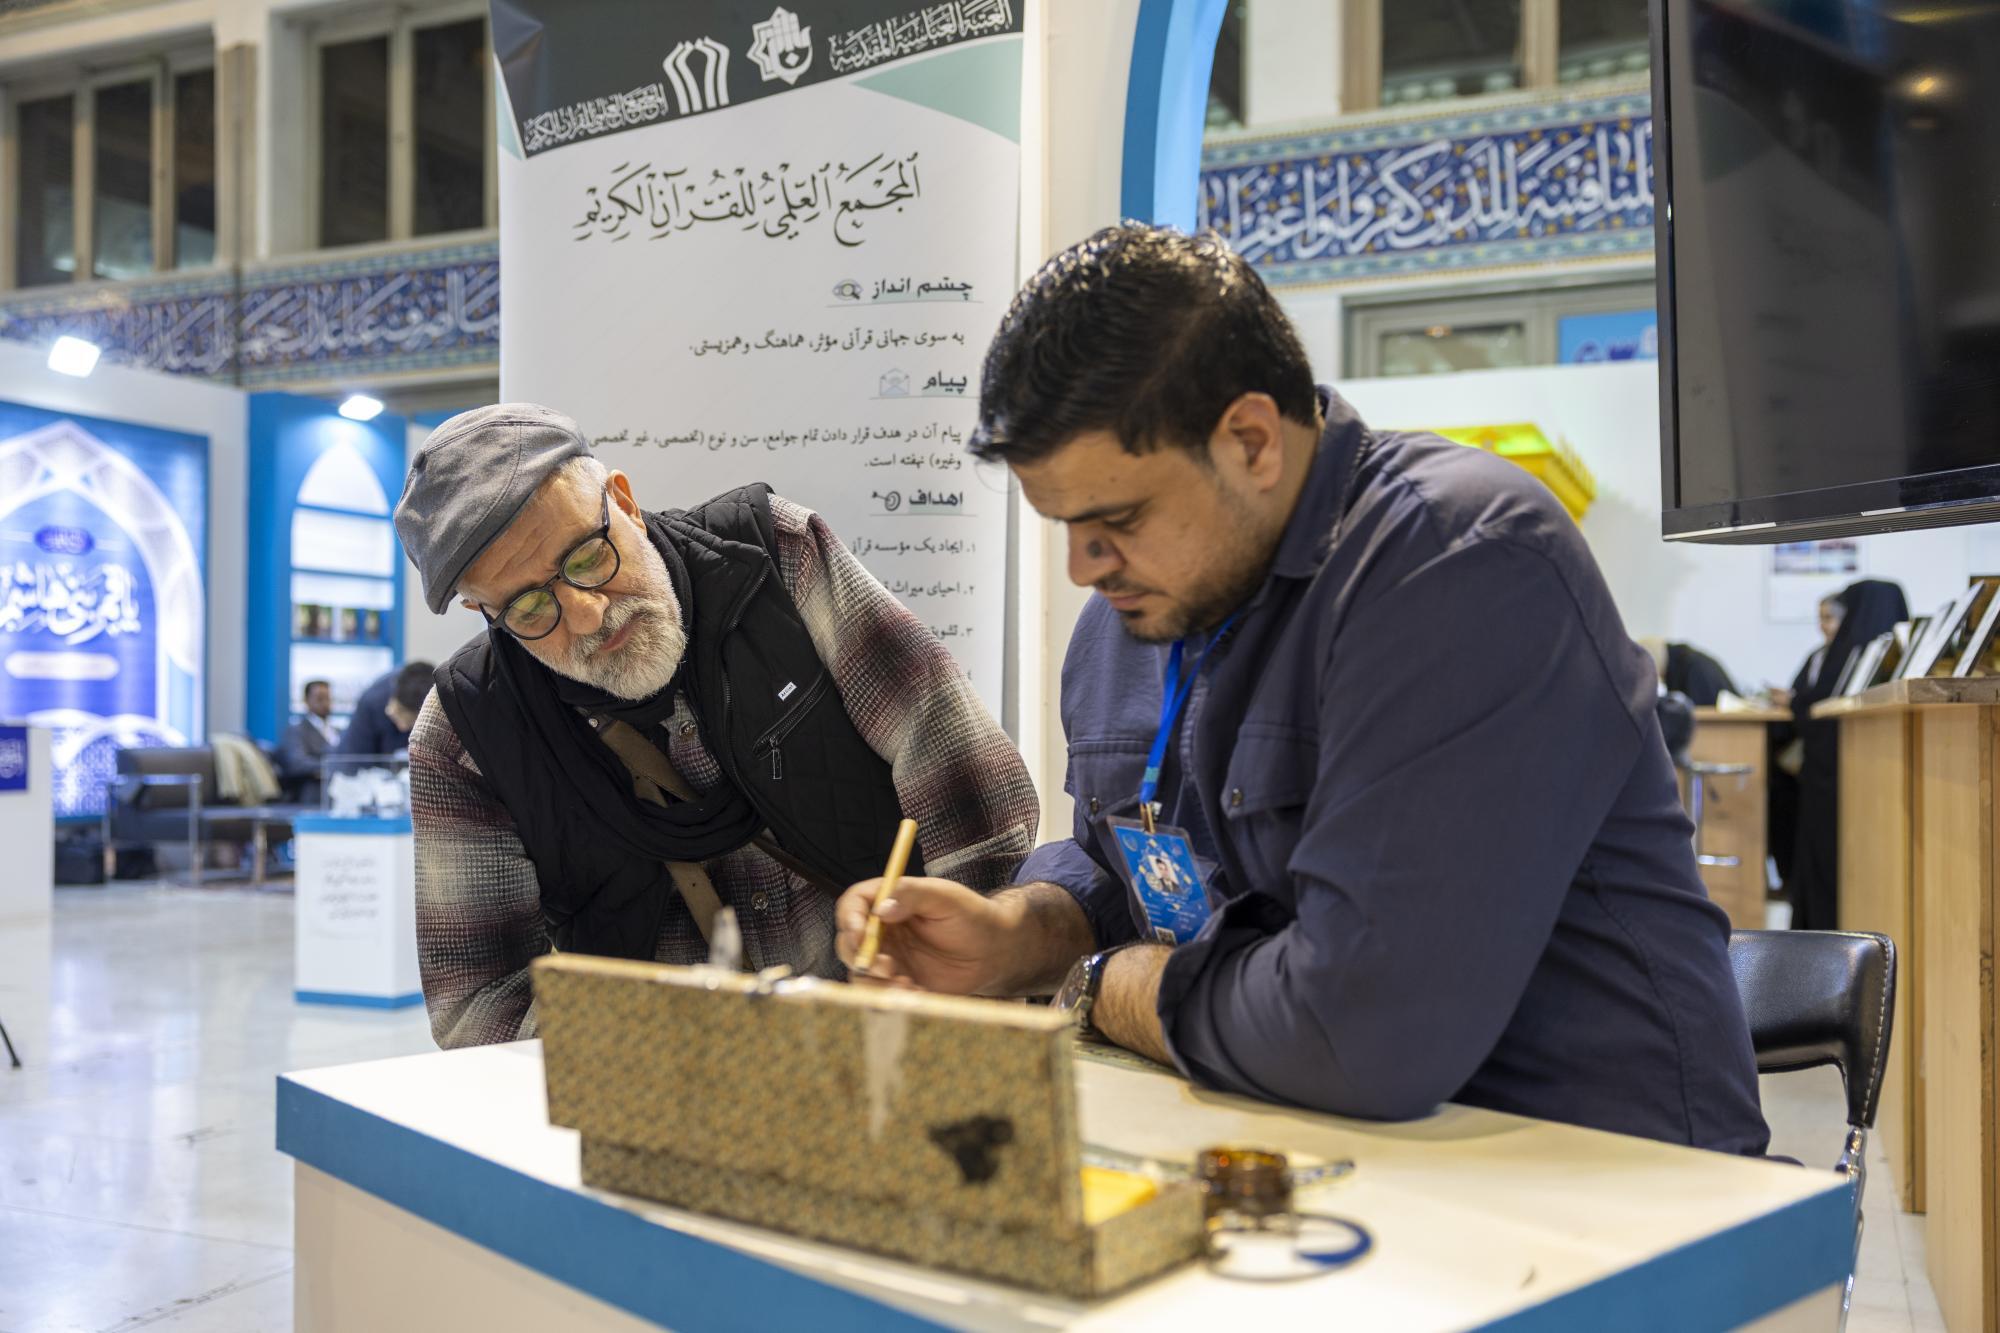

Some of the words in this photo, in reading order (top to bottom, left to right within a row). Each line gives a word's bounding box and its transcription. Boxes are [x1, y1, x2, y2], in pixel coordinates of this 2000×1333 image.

[872, 277, 911, 300] انداز
[917, 277, 973, 301] چشم
[754, 329, 804, 349] هماهنگ
[842, 327, 873, 350] قرآنی
[876, 328, 909, 348] جهانی
[914, 332, 947, 347] سوی
[952, 332, 965, 345] به
[922, 370, 968, 394] پیام
[802, 428, 818, 447] تمام
[822, 428, 847, 443] دادن
[851, 427, 870, 445] قرار
[873, 428, 901, 440] هدف
[904, 428, 918, 443] در
[922, 422, 938, 439] آن
[941, 426, 961, 444] پیام
[708, 431, 727, 450] نوع
[909, 488, 963, 506] اهداف
